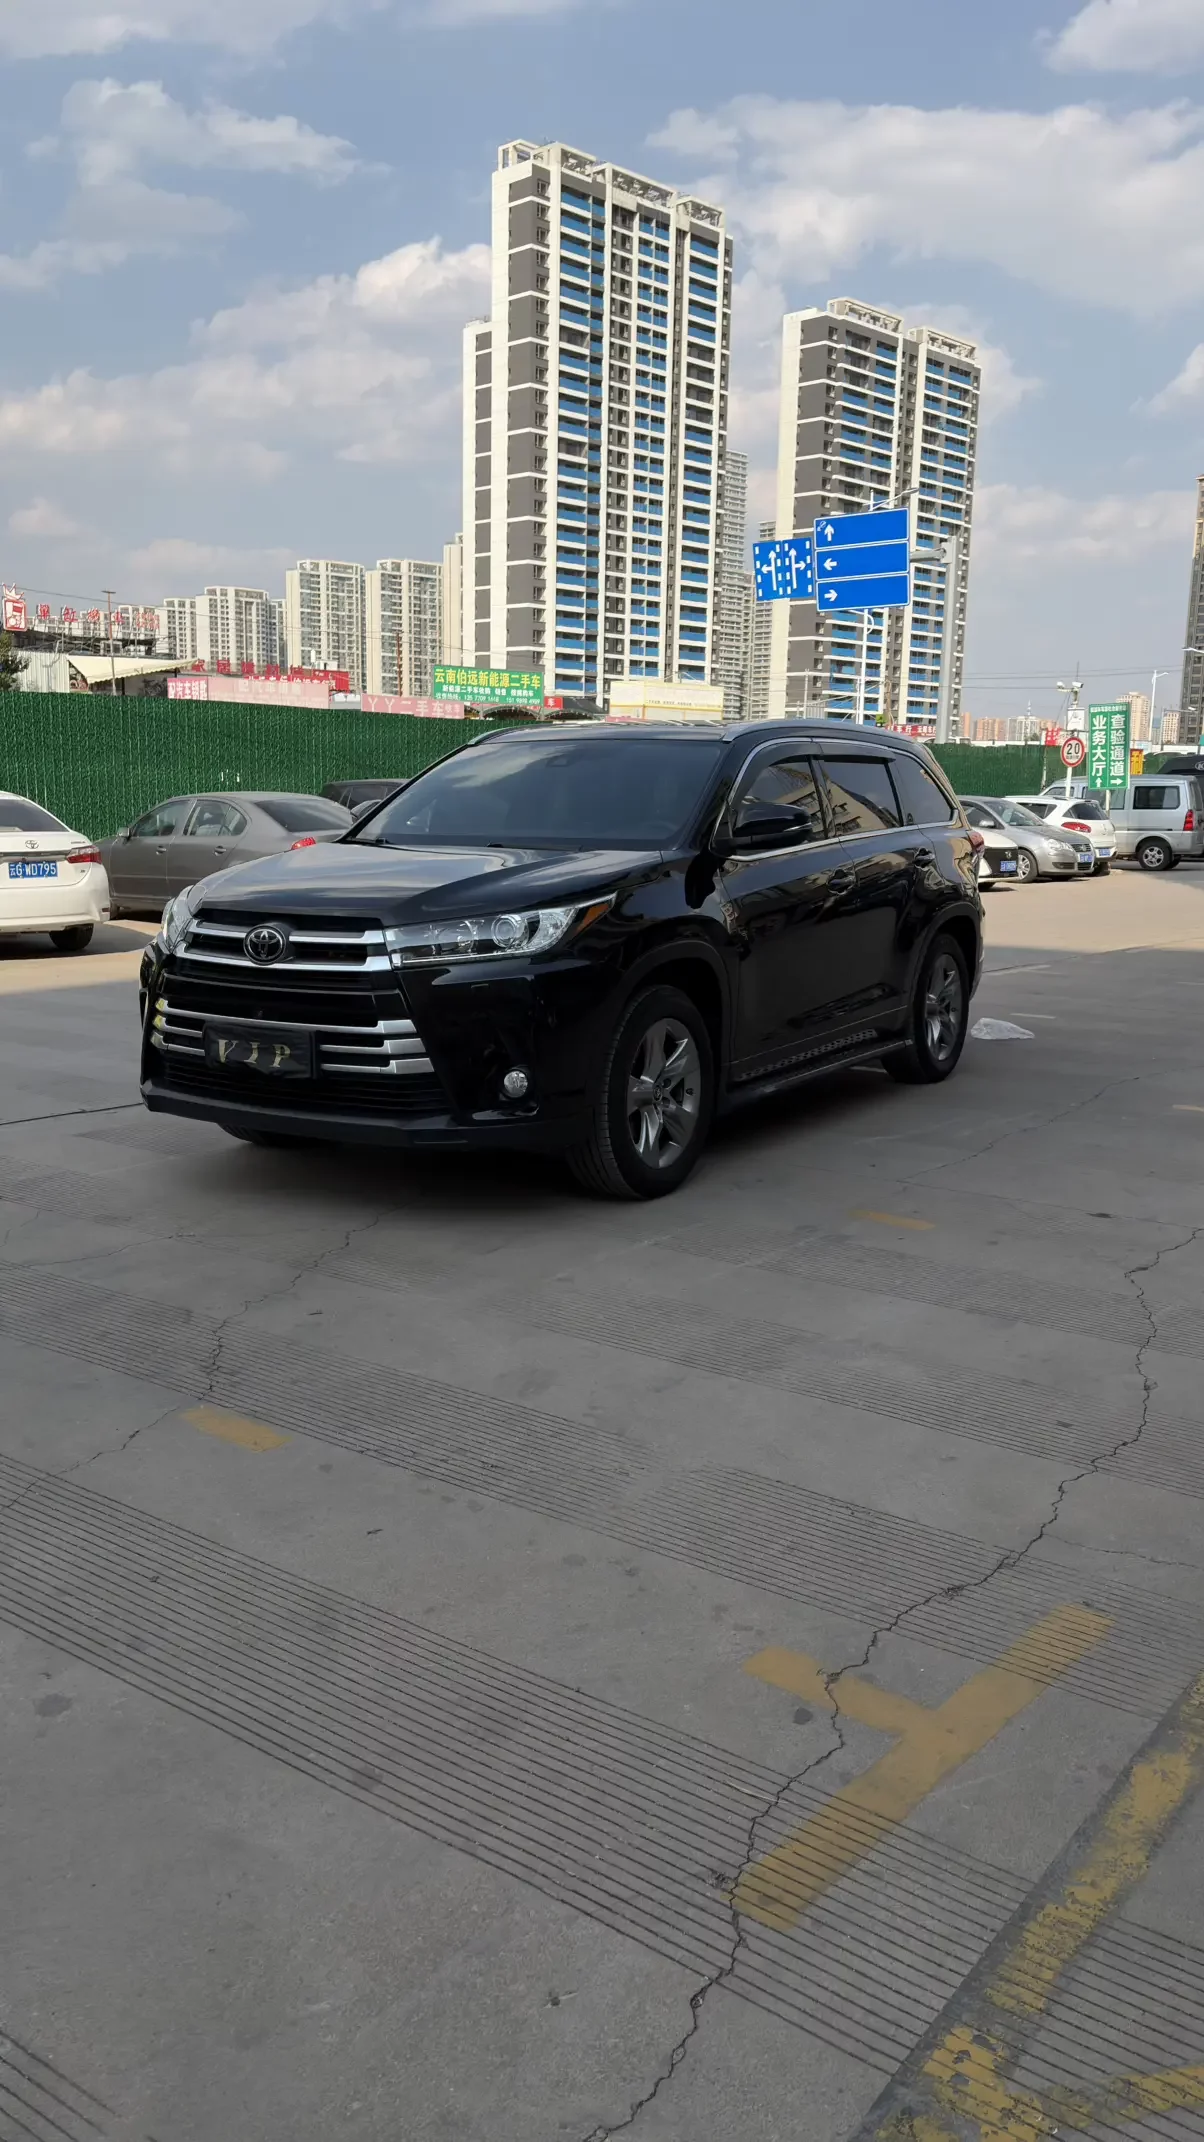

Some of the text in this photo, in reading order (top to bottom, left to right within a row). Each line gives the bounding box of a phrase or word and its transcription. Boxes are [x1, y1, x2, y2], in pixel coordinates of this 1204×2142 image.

[434, 668, 541, 689] 云南伯远新能源二手车
[1066, 742, 1080, 755] 20
[1091, 714, 1107, 777] 业务大厅
[1110, 713, 1126, 777] 查验通道
[217, 1038, 291, 1069] VIP
